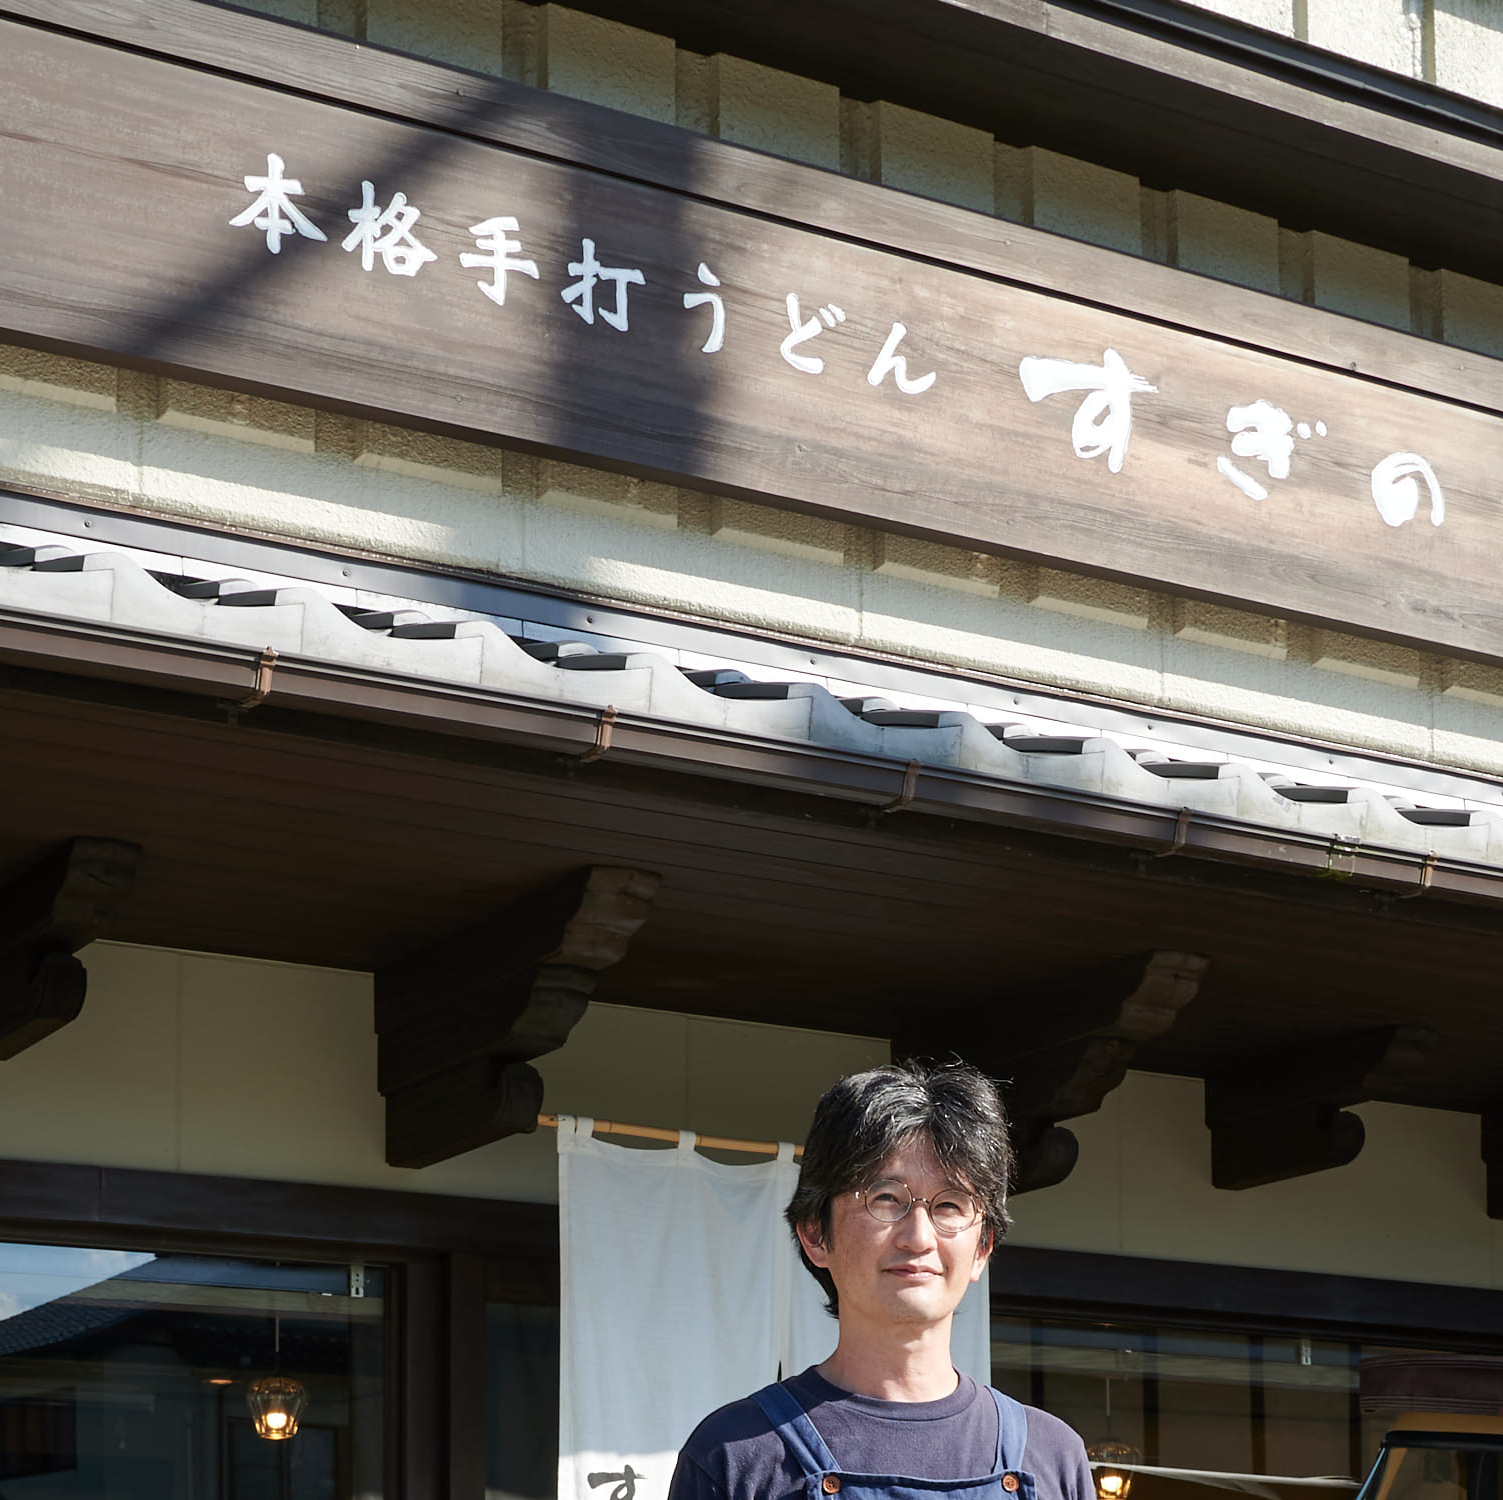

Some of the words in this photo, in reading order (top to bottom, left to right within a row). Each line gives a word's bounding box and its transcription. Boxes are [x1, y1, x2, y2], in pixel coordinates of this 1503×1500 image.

[229, 153, 937, 394] 本格手打うどん
